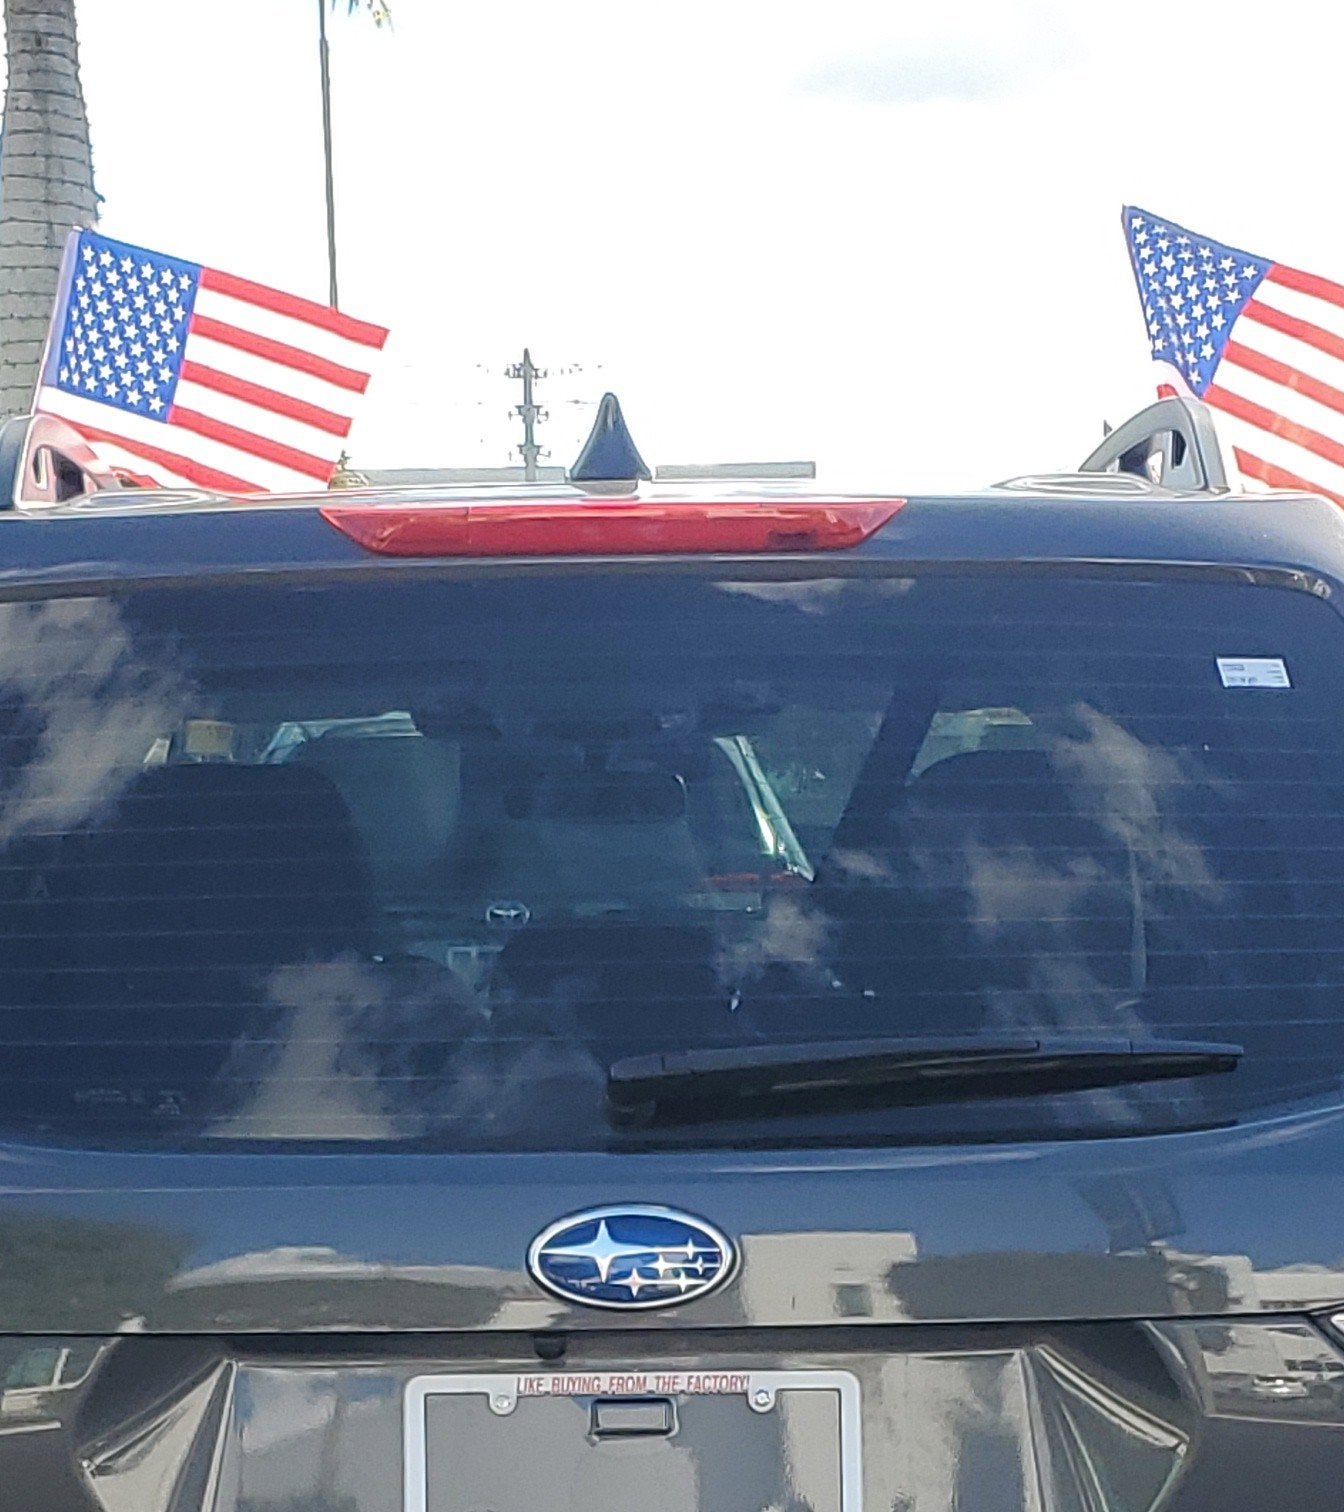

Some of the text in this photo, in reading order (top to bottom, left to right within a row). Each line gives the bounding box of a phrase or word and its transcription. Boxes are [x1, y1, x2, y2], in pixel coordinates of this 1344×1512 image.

[516, 1375, 750, 1394] LIKE BUYING FROM THE FACTORY!
